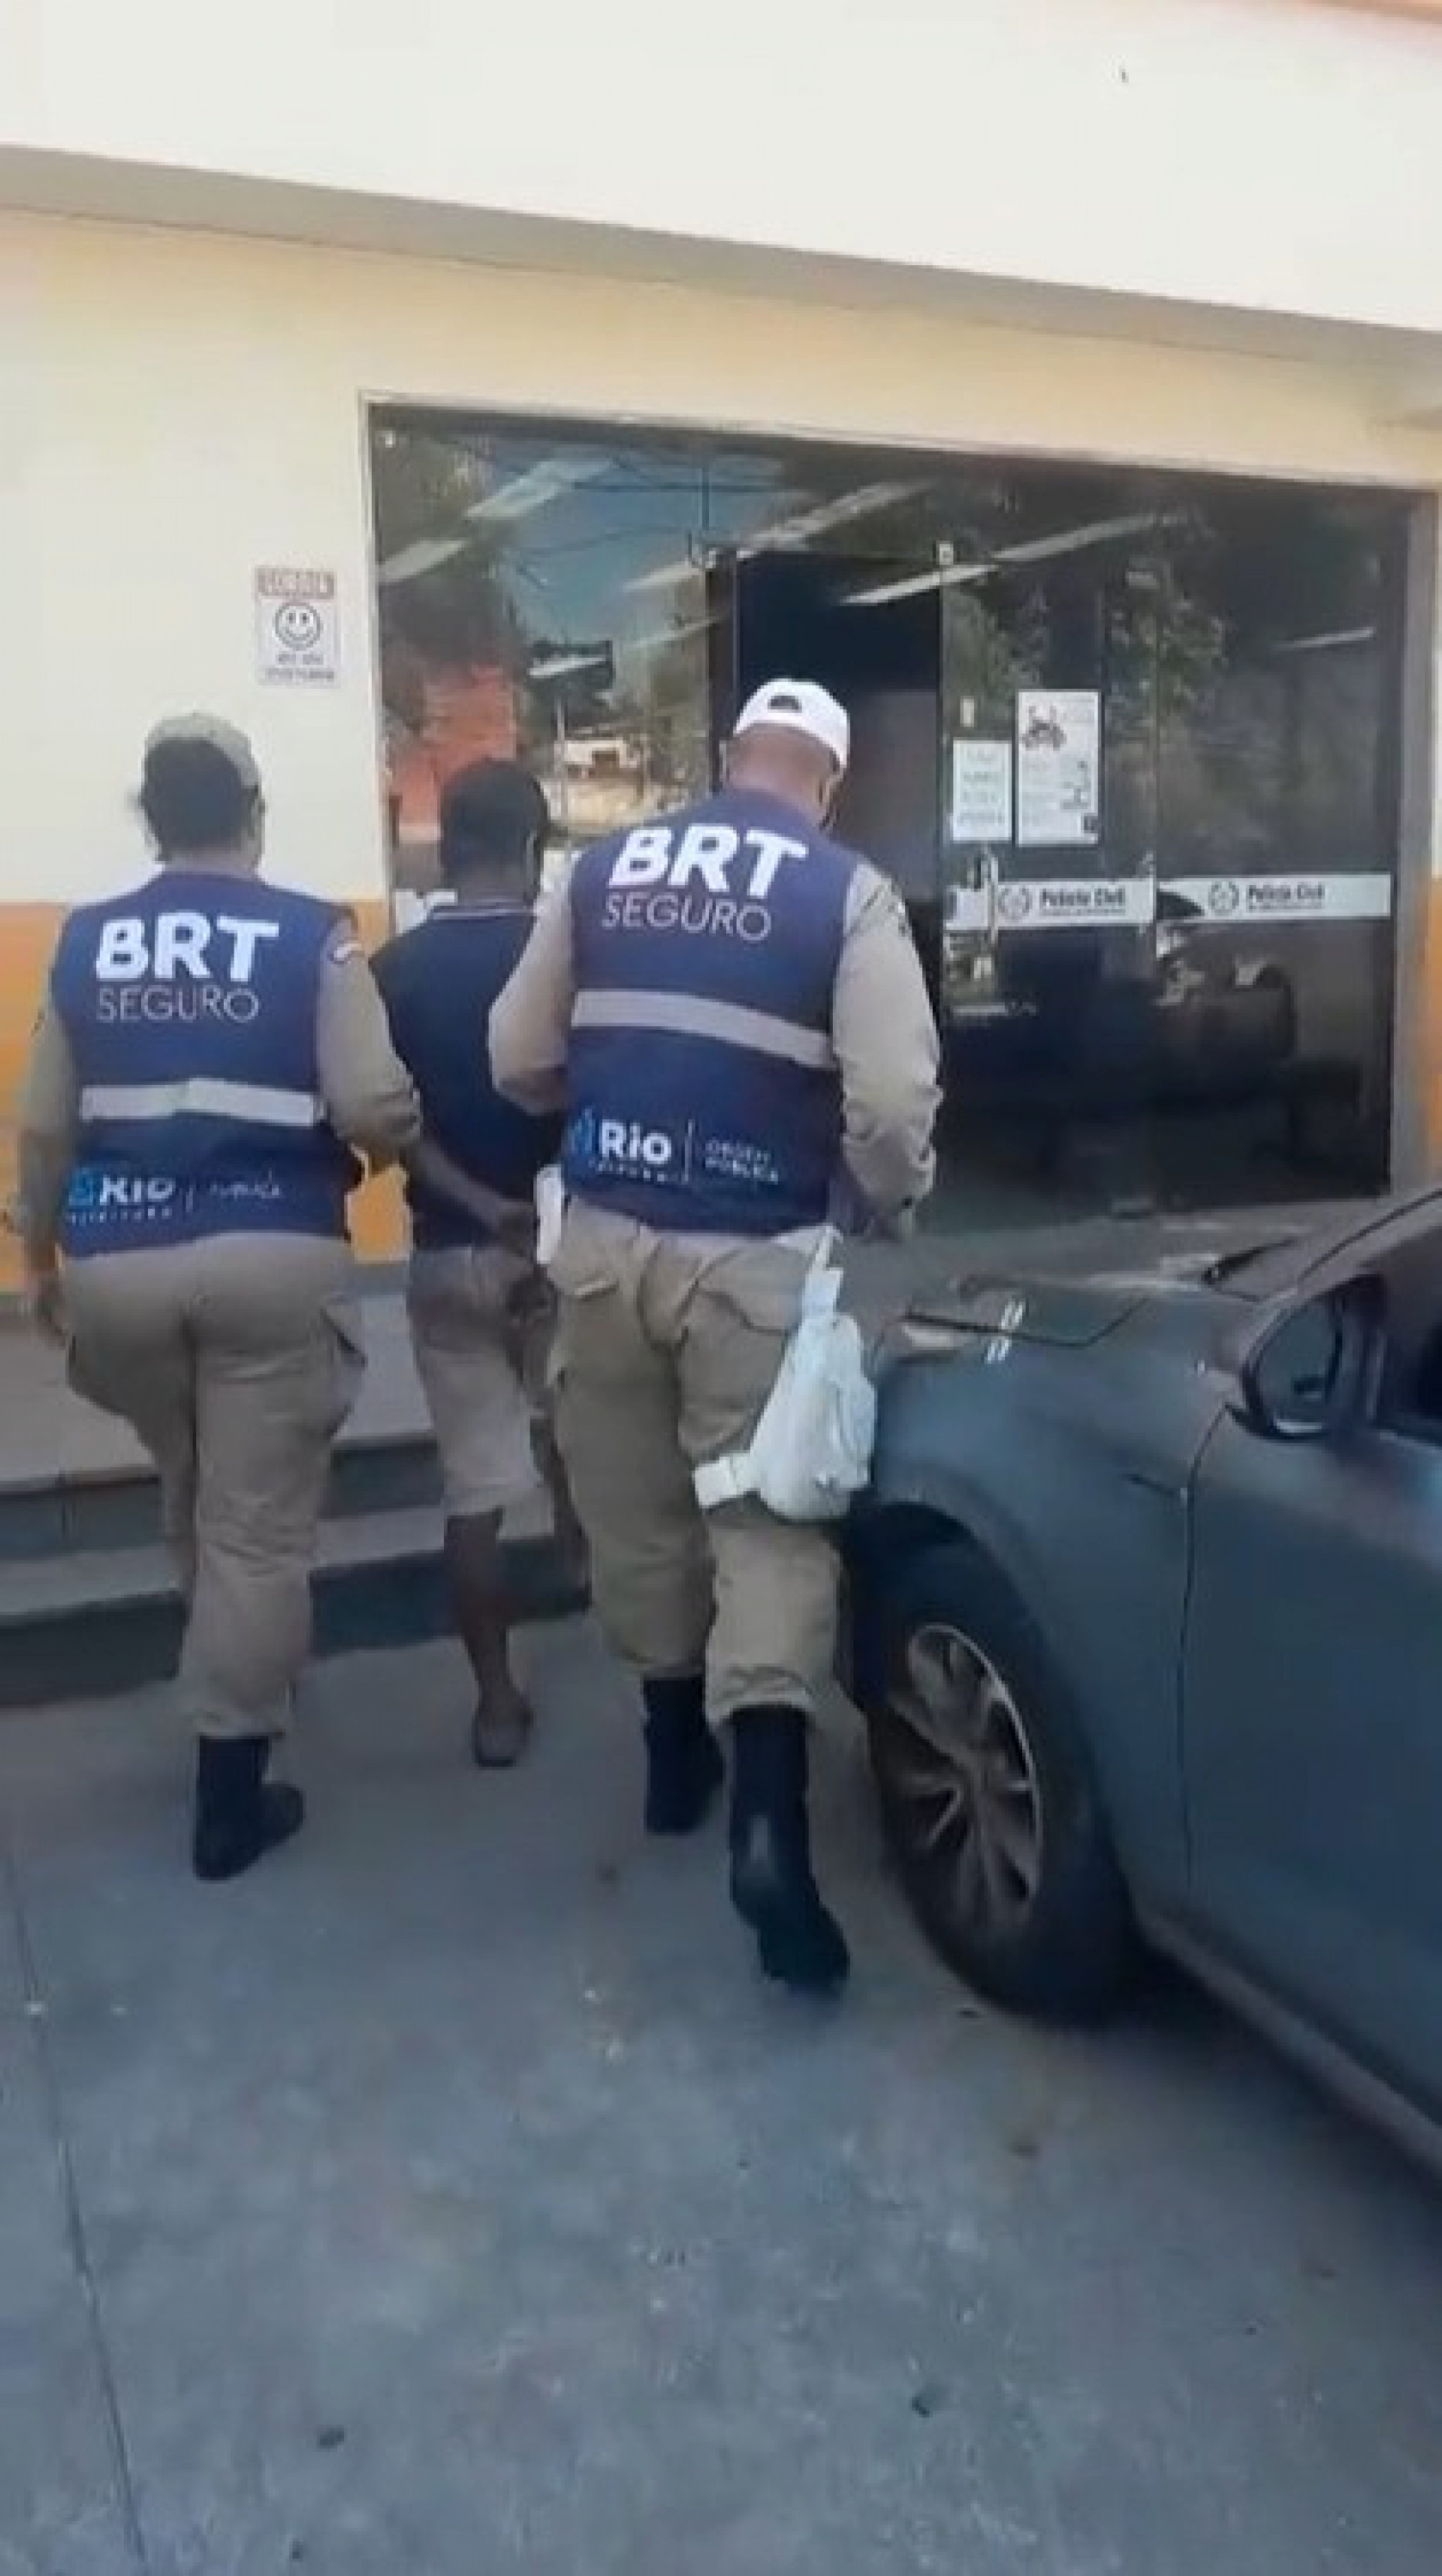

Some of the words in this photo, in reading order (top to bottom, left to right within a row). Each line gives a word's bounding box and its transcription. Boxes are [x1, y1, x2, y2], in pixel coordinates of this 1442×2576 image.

[608, 824, 808, 897] BRT
[603, 892, 771, 940] SEGURO
[96, 911, 279, 982] BRT
[97, 986, 259, 1022] SEGURO
[600, 1120, 671, 1164] Rio
